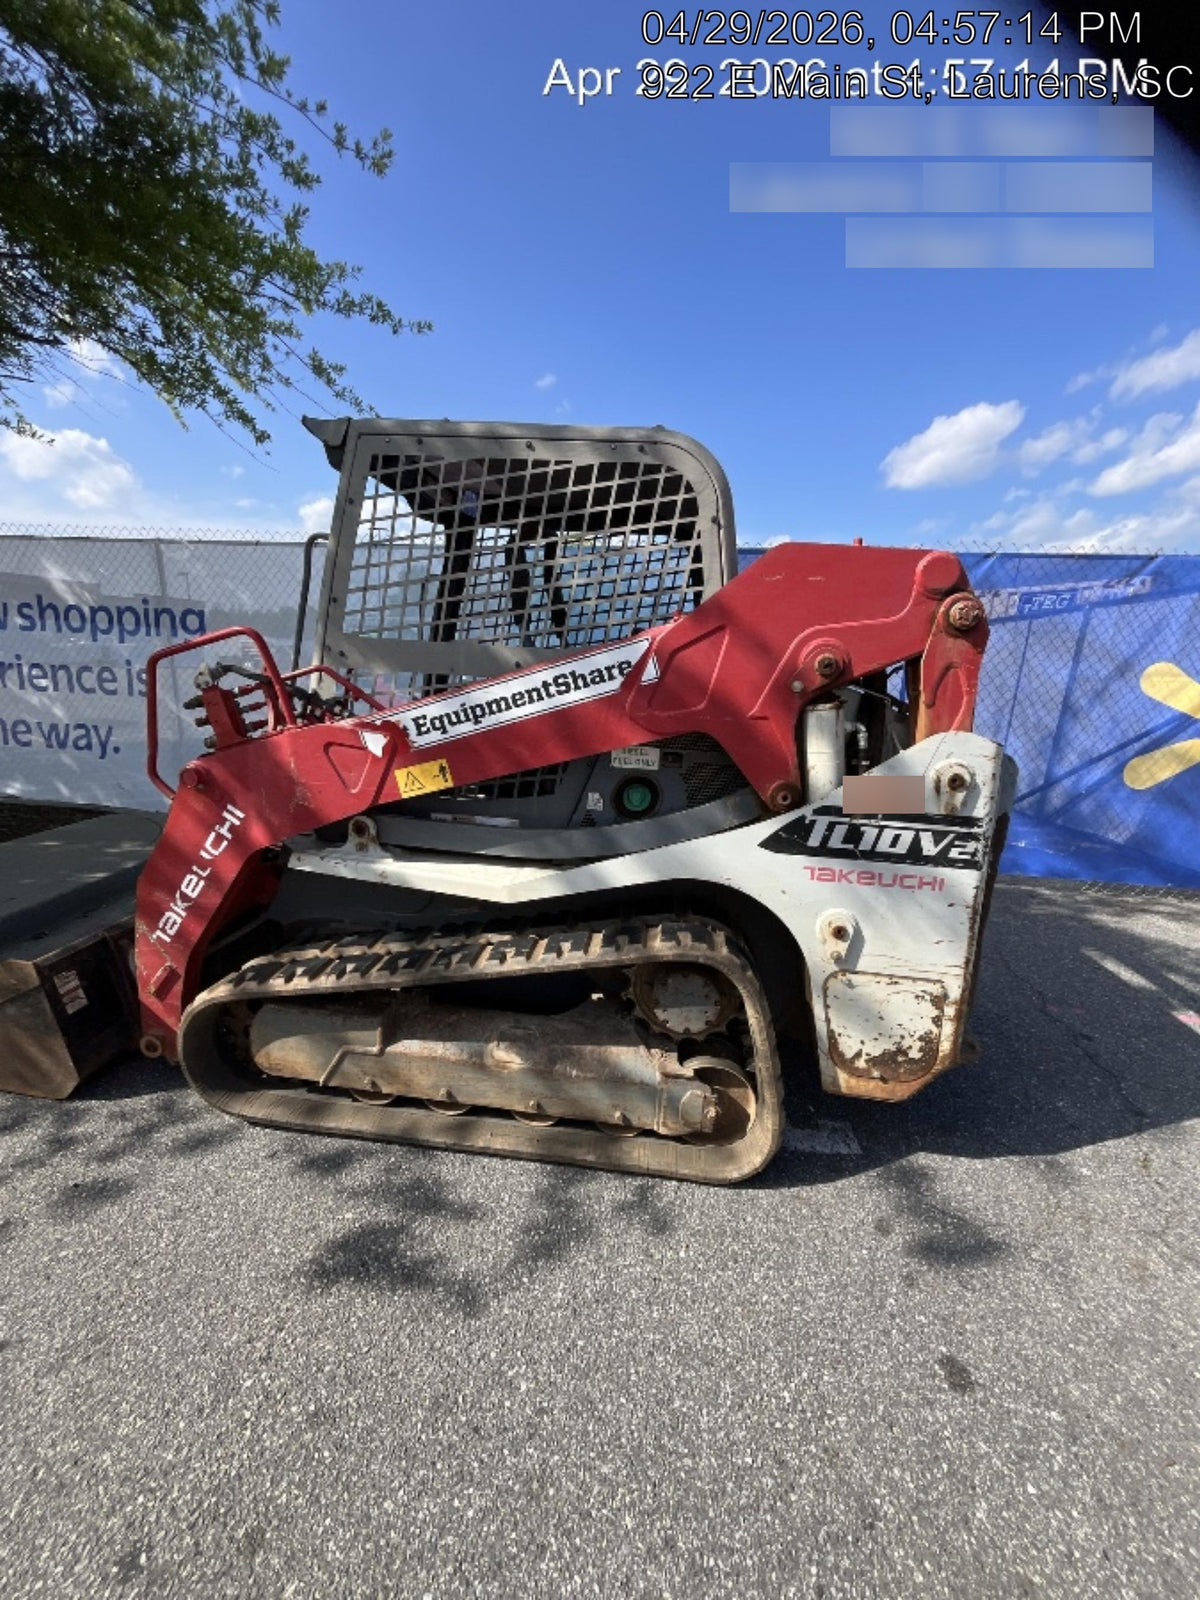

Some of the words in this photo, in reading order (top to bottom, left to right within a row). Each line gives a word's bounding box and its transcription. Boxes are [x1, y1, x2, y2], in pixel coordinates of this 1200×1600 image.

[17, 595, 207, 643] shopping
[411, 659, 632, 737] EquipmentShare
[37, 720, 120, 759] way.
[805, 814, 977, 860] TL10V2
